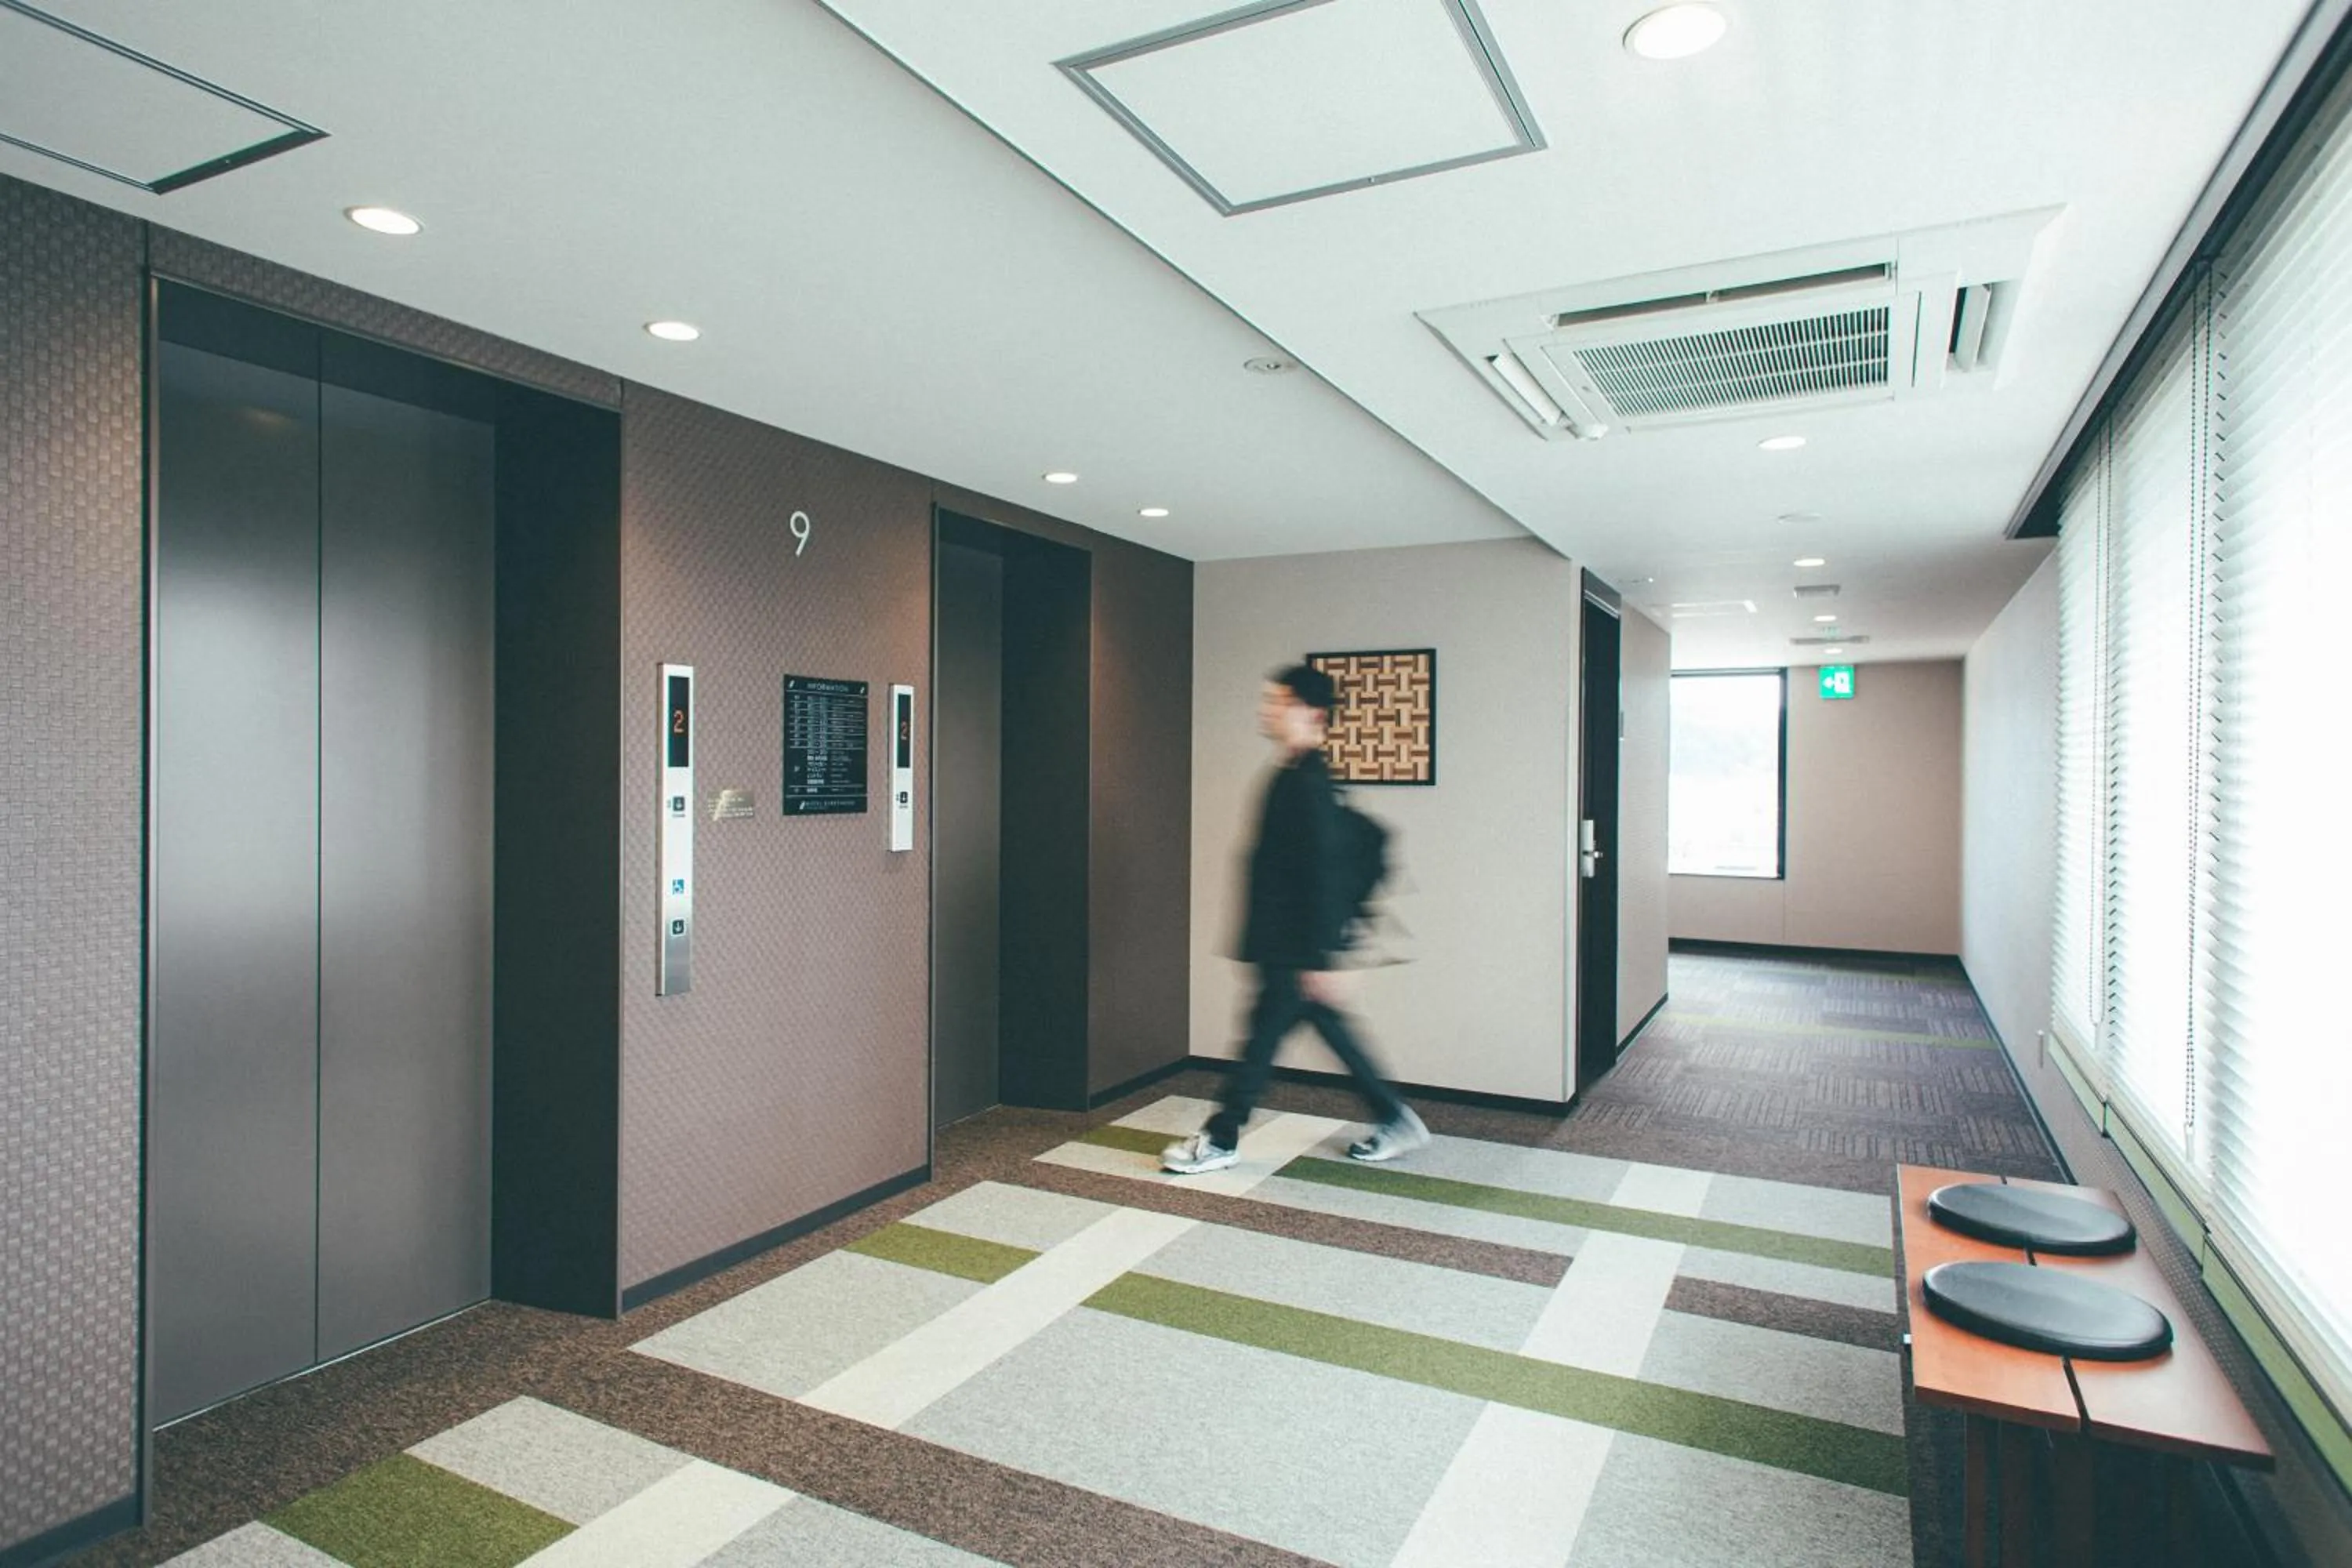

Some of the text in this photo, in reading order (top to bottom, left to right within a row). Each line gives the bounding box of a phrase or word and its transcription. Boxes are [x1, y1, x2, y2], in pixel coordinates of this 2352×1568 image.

[790, 511, 810, 557] 9
[673, 710, 684, 733] 2
[900, 721, 907, 740] 2
